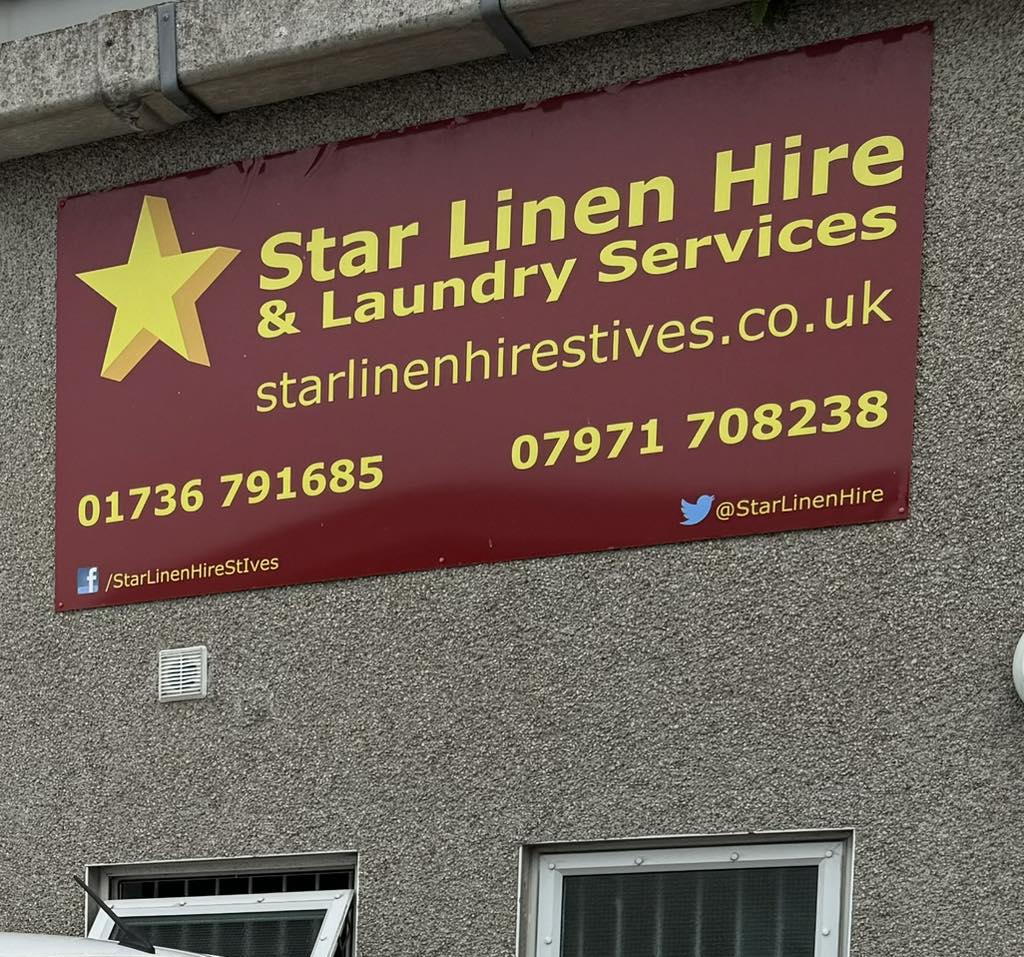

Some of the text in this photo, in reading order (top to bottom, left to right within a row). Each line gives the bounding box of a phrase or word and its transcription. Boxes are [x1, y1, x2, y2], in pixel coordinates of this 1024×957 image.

[259, 133, 905, 291] Star Linen Hire
[257, 205, 897, 338] & Laundry Services
[256, 280, 893, 413] starlinenhirestives.co.uk
[511, 389, 888, 470] 07971 708238
[77, 455, 384, 527] 01736 791685
[716, 487, 884, 521] @StarLinenHire
[105, 557, 280, 592] /StarLinenHireStIves
